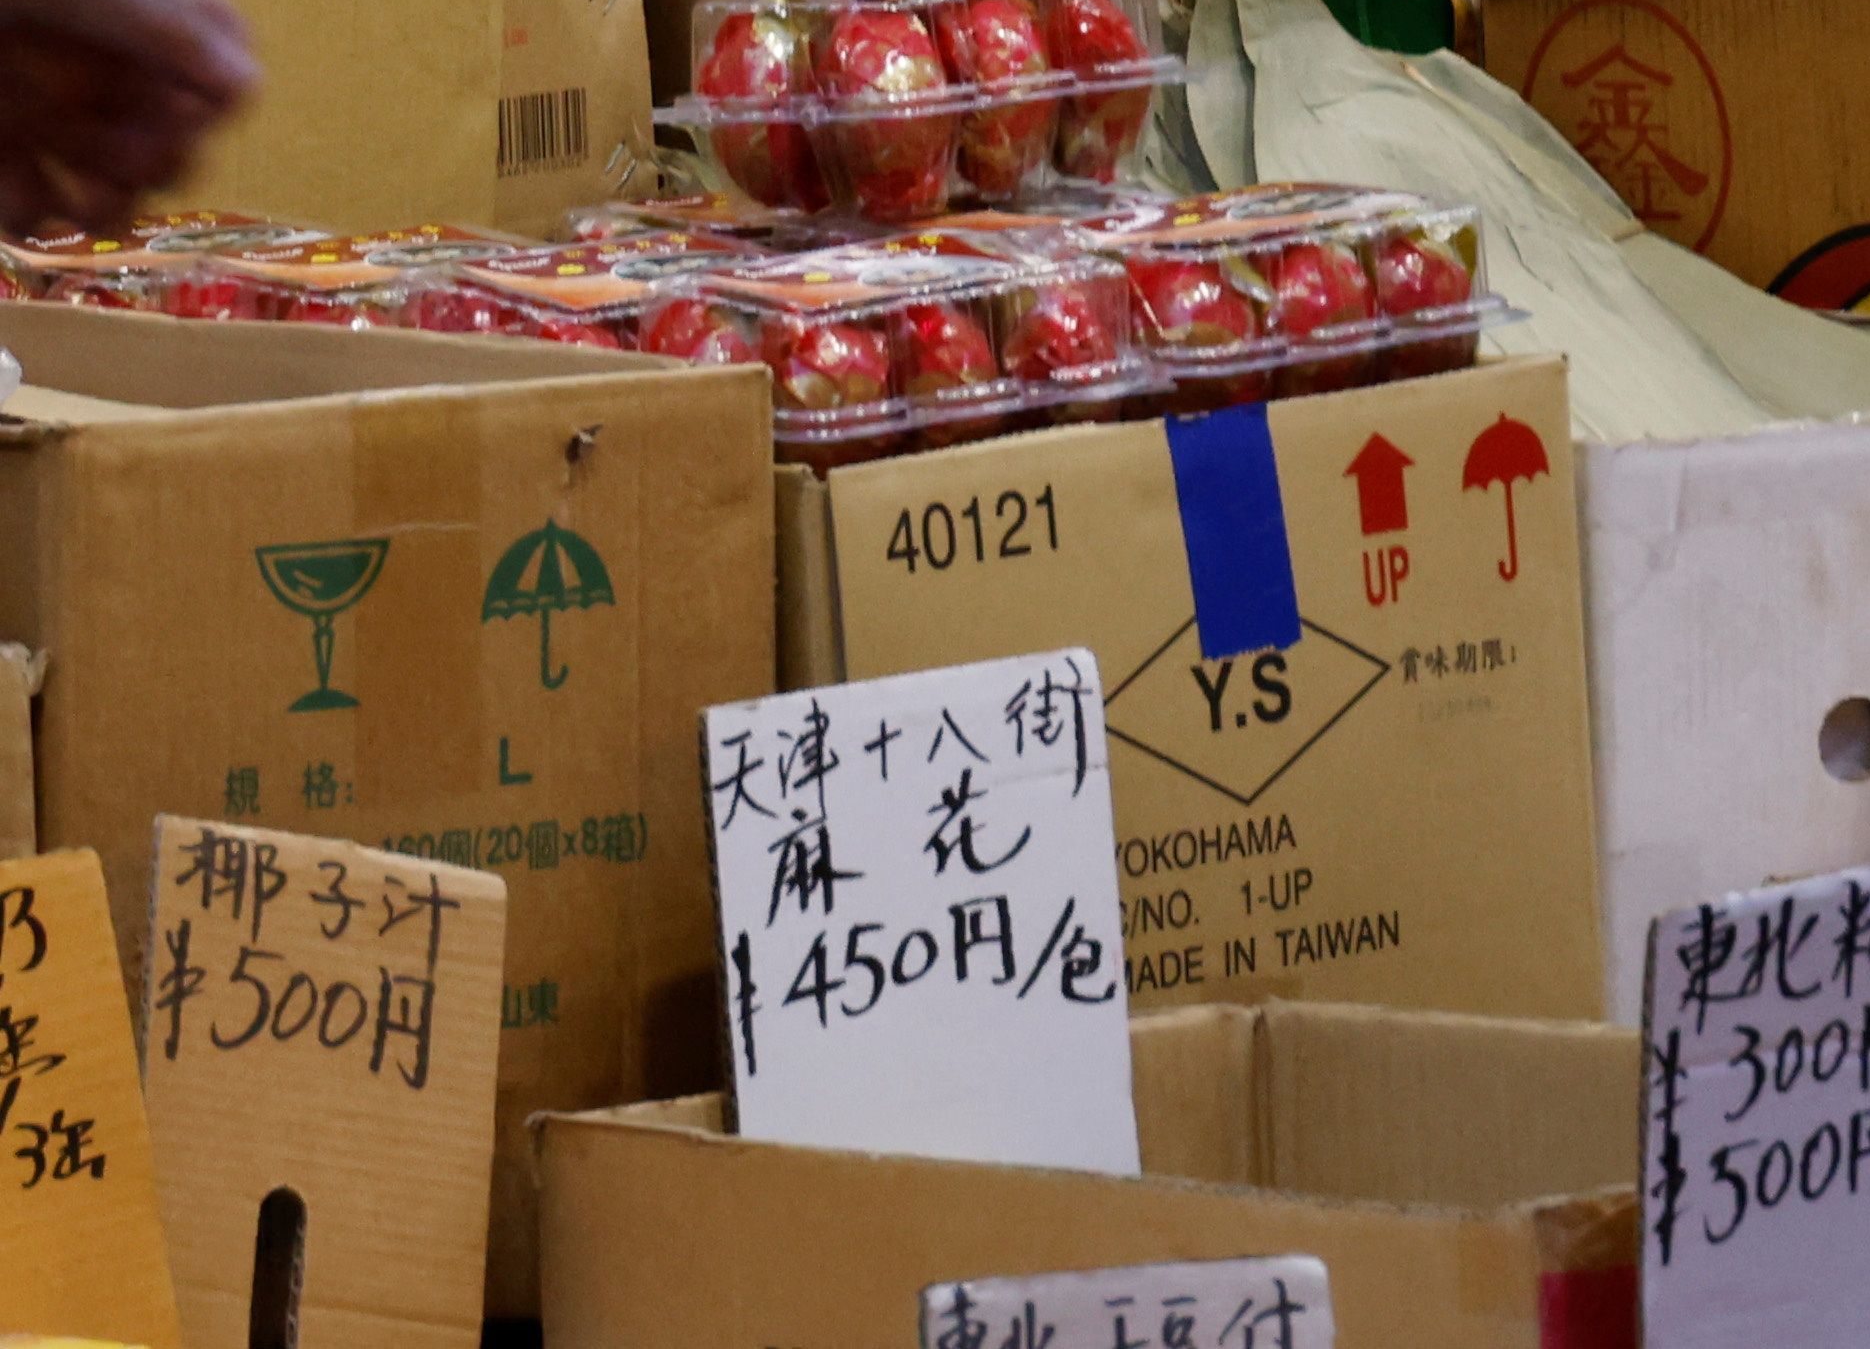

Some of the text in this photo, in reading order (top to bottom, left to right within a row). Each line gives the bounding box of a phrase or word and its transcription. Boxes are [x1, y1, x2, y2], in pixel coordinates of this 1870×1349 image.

[886, 484, 1060, 574] 40121
[1361, 545, 1411, 606] UP
[1192, 651, 1293, 732] Y.S
[499, 736, 534, 788] L
[712, 655, 1093, 830] 天津十八街
[765, 767, 1034, 930] 麻花
[1240, 867, 1313, 917] 1-UP
[730, 894, 1118, 1078] ¥450円/包
[1224, 909, 1401, 978] IN TAIWAN
[155, 918, 436, 1090] ¥500円
